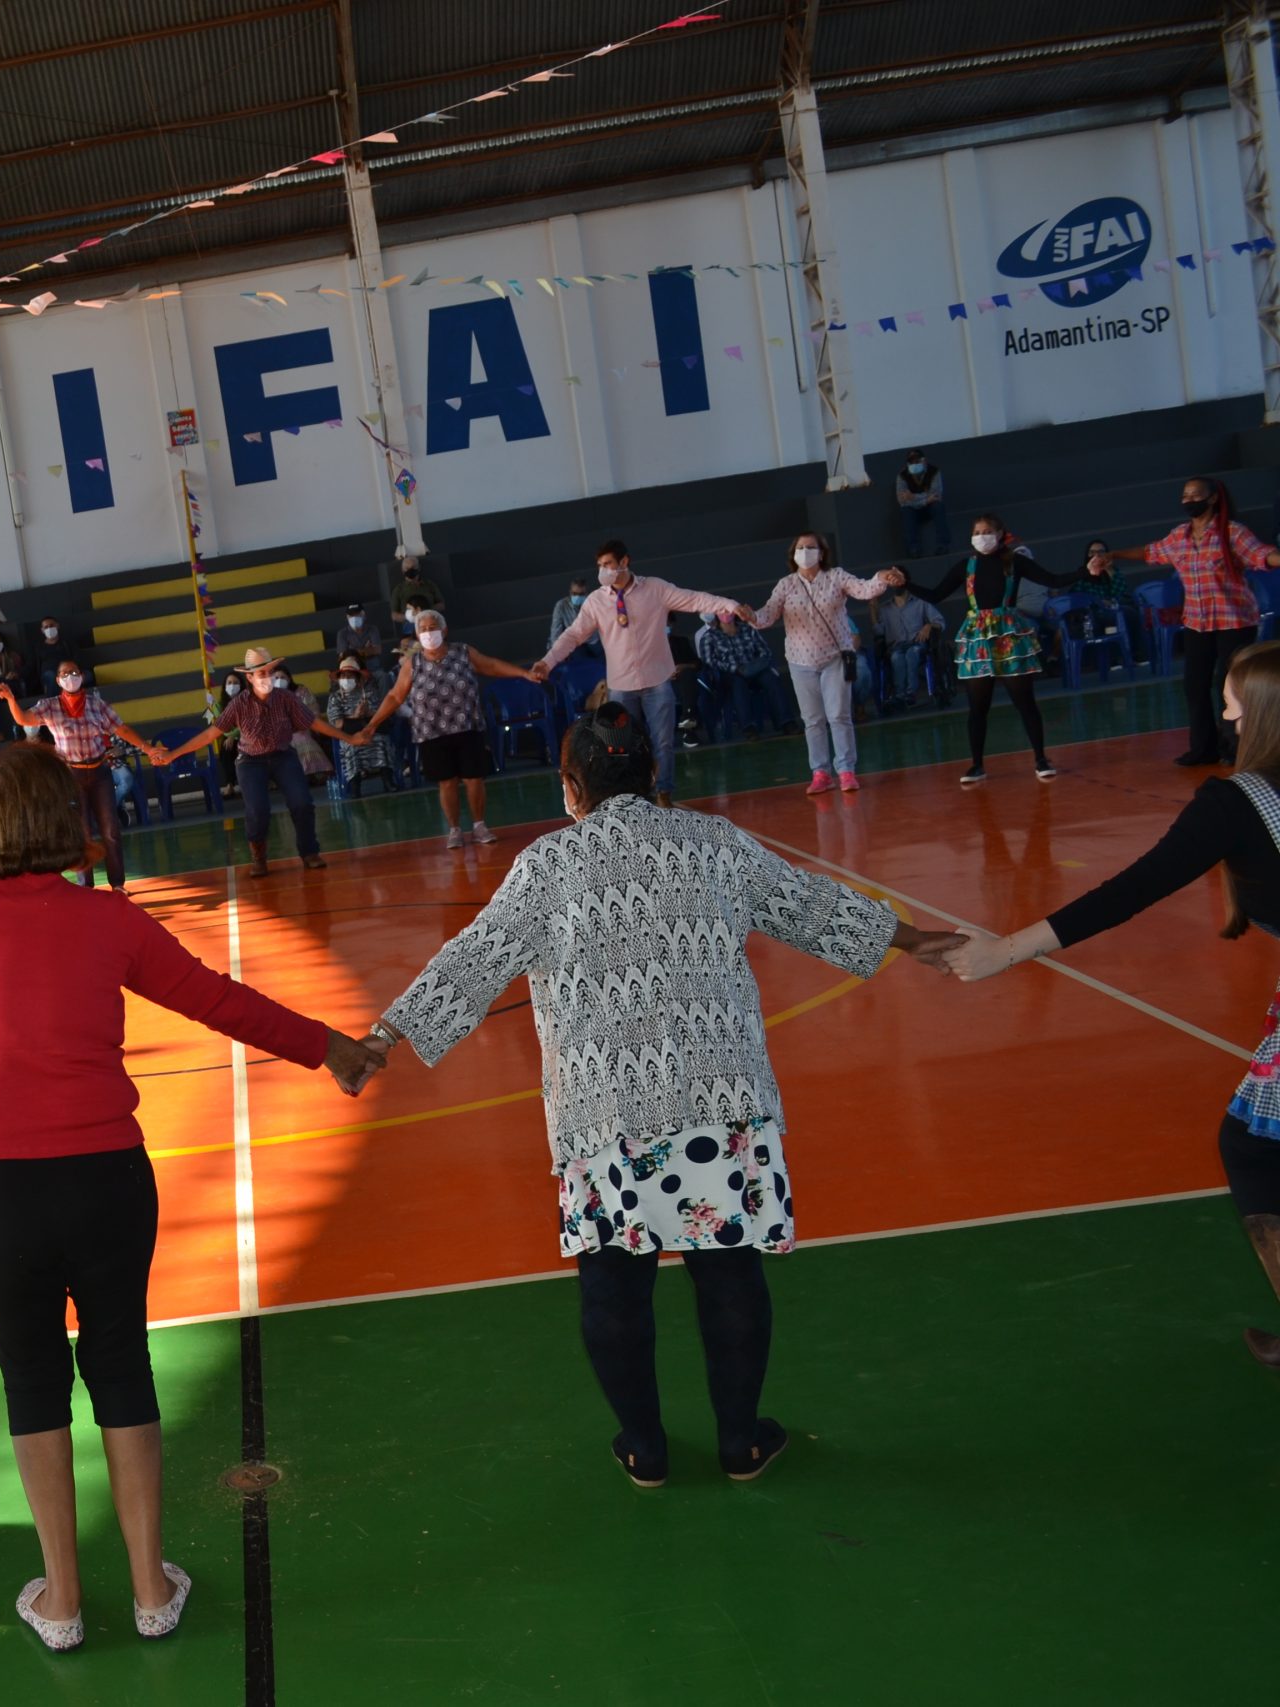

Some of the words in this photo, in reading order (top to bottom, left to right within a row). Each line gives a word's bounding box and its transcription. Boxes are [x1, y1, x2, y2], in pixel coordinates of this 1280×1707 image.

[1053, 227, 1070, 262] UNI
[1070, 211, 1145, 261] FAI
[1004, 306, 1170, 357] Adamantina-SP
